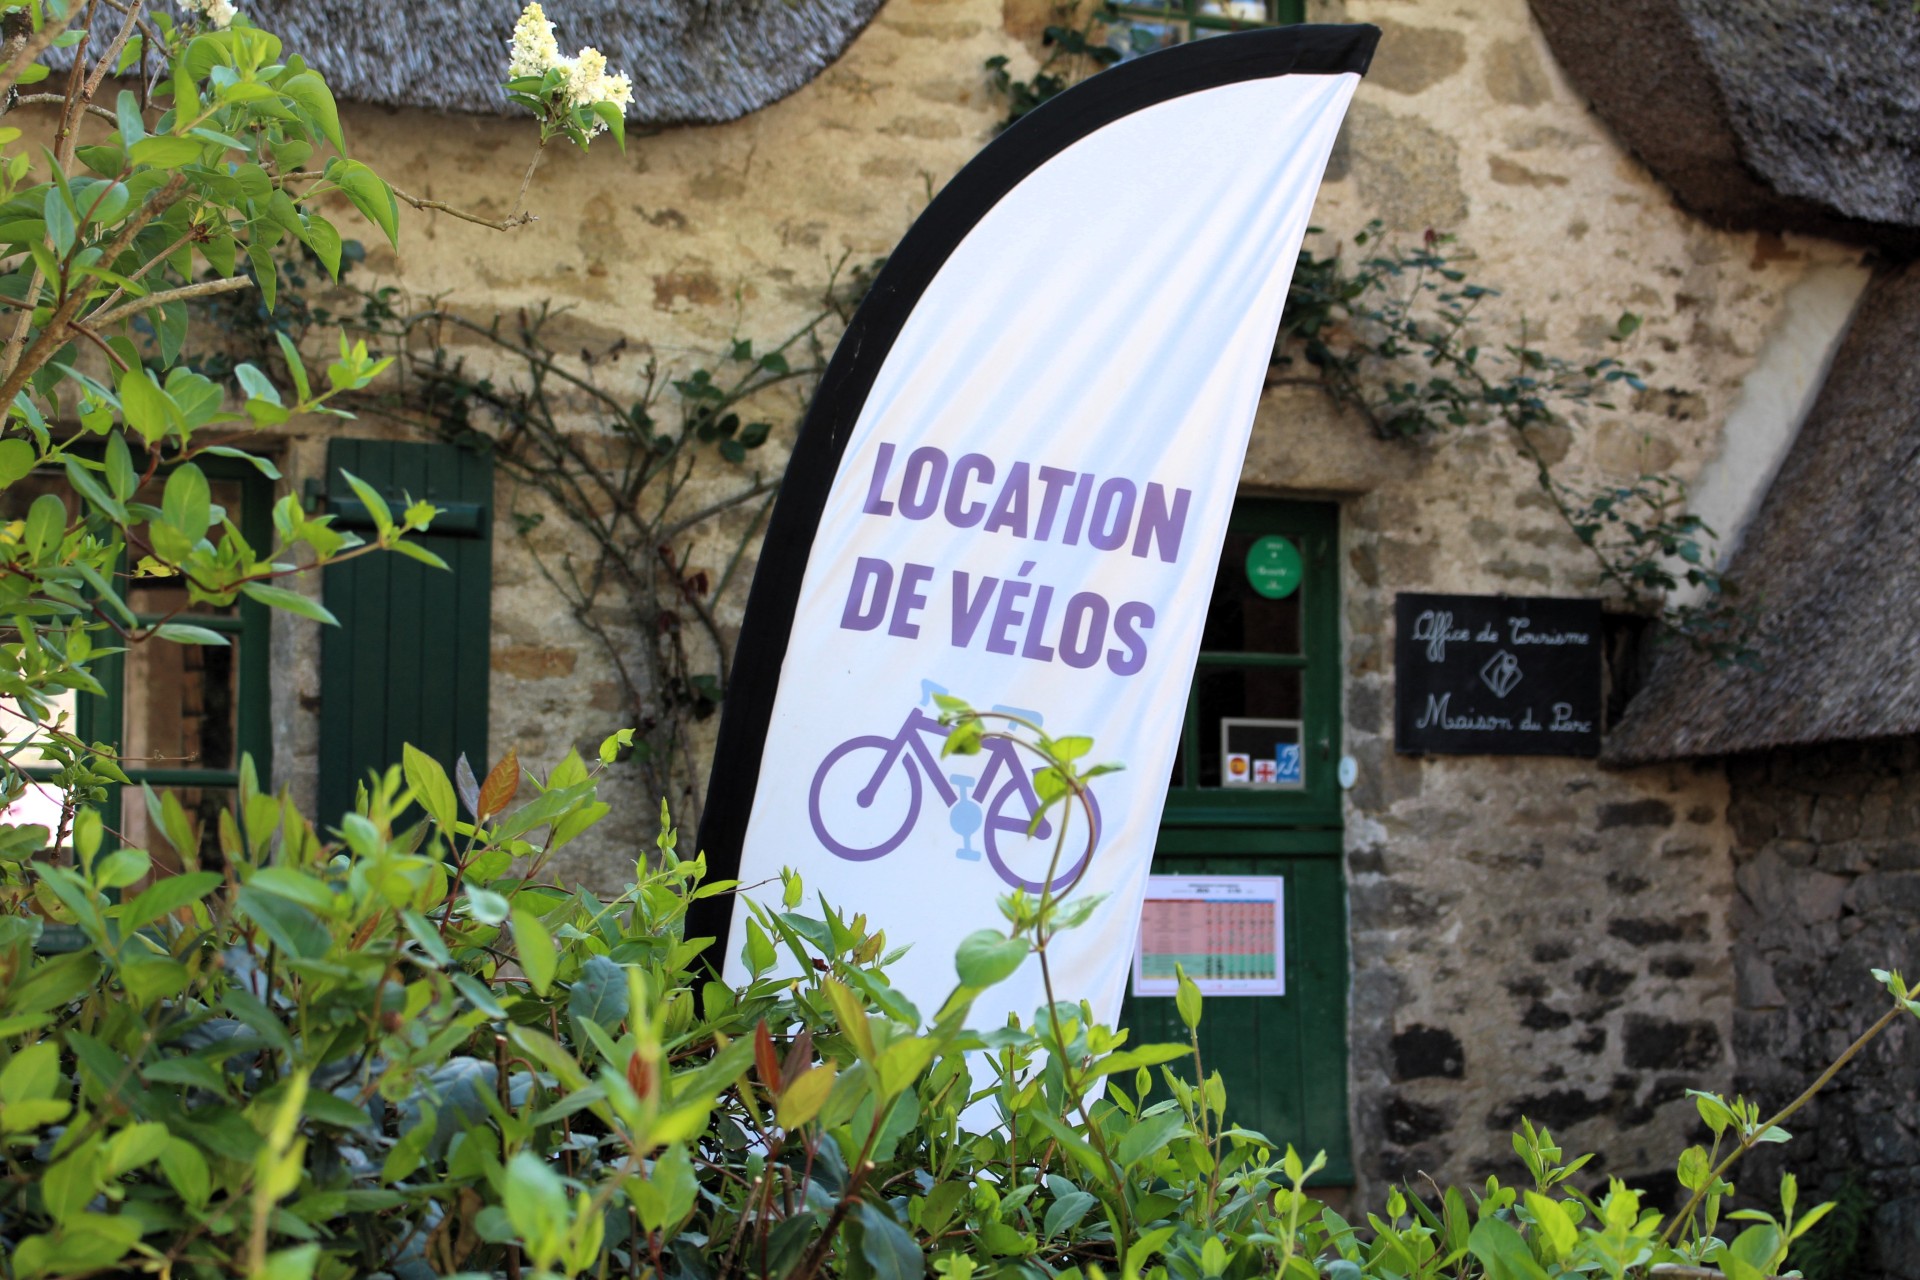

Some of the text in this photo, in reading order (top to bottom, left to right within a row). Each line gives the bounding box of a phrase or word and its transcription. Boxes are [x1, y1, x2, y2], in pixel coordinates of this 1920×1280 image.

[862, 442, 1192, 564] LOCATION
[840, 556, 1155, 676] DE VÉLOS
[1412, 609, 1590, 663] Office de Tourisme
[1415, 692, 1593, 733] Maison du Parc
